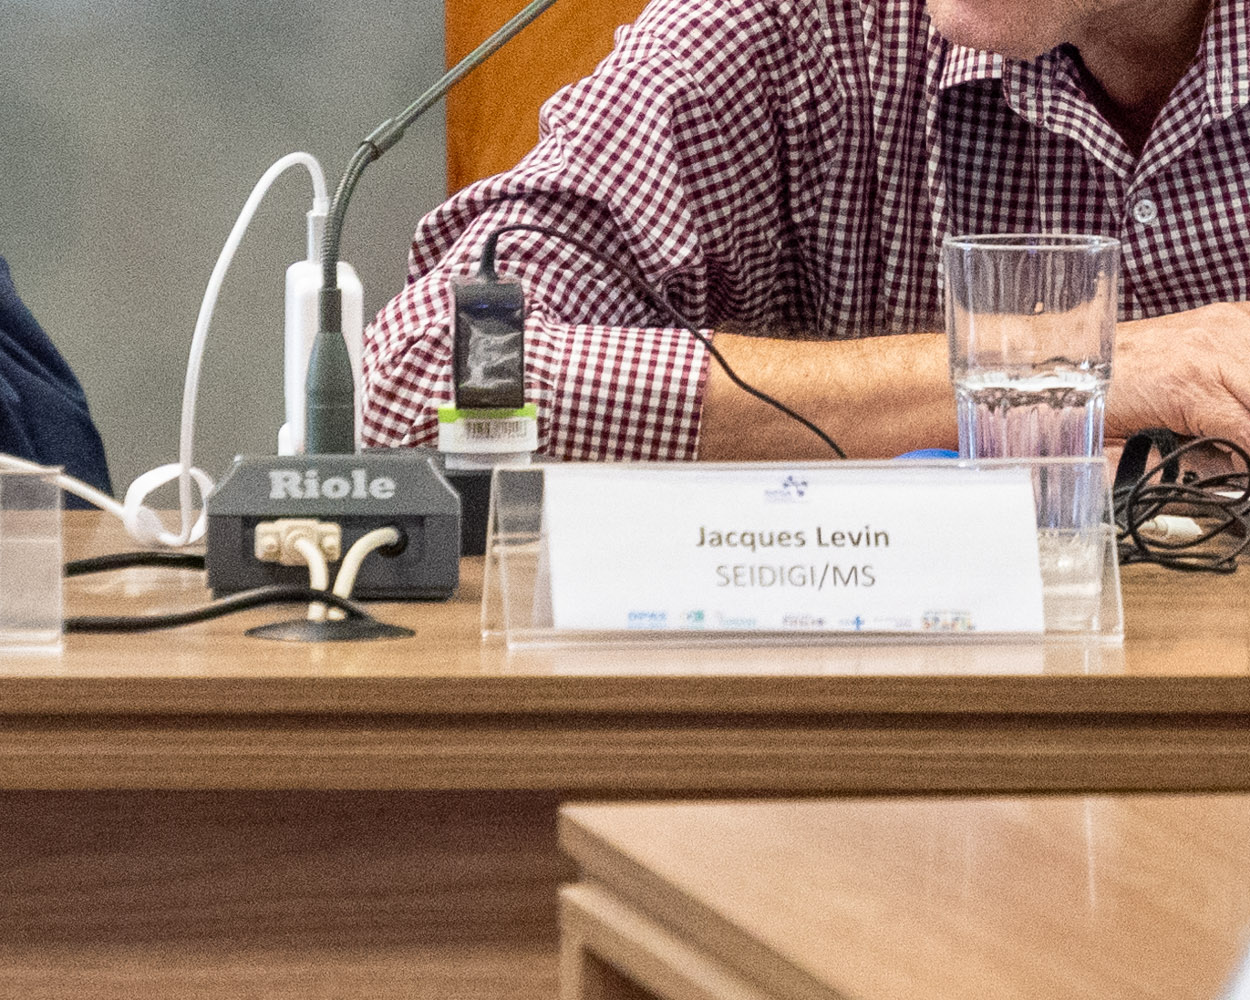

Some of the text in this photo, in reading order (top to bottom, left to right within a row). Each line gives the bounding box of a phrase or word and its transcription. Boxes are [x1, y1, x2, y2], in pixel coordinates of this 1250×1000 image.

[268, 468, 396, 500] Riole
[696, 525, 890, 553] Jacques Levin
[715, 562, 877, 591] SEIDIGI/MS
